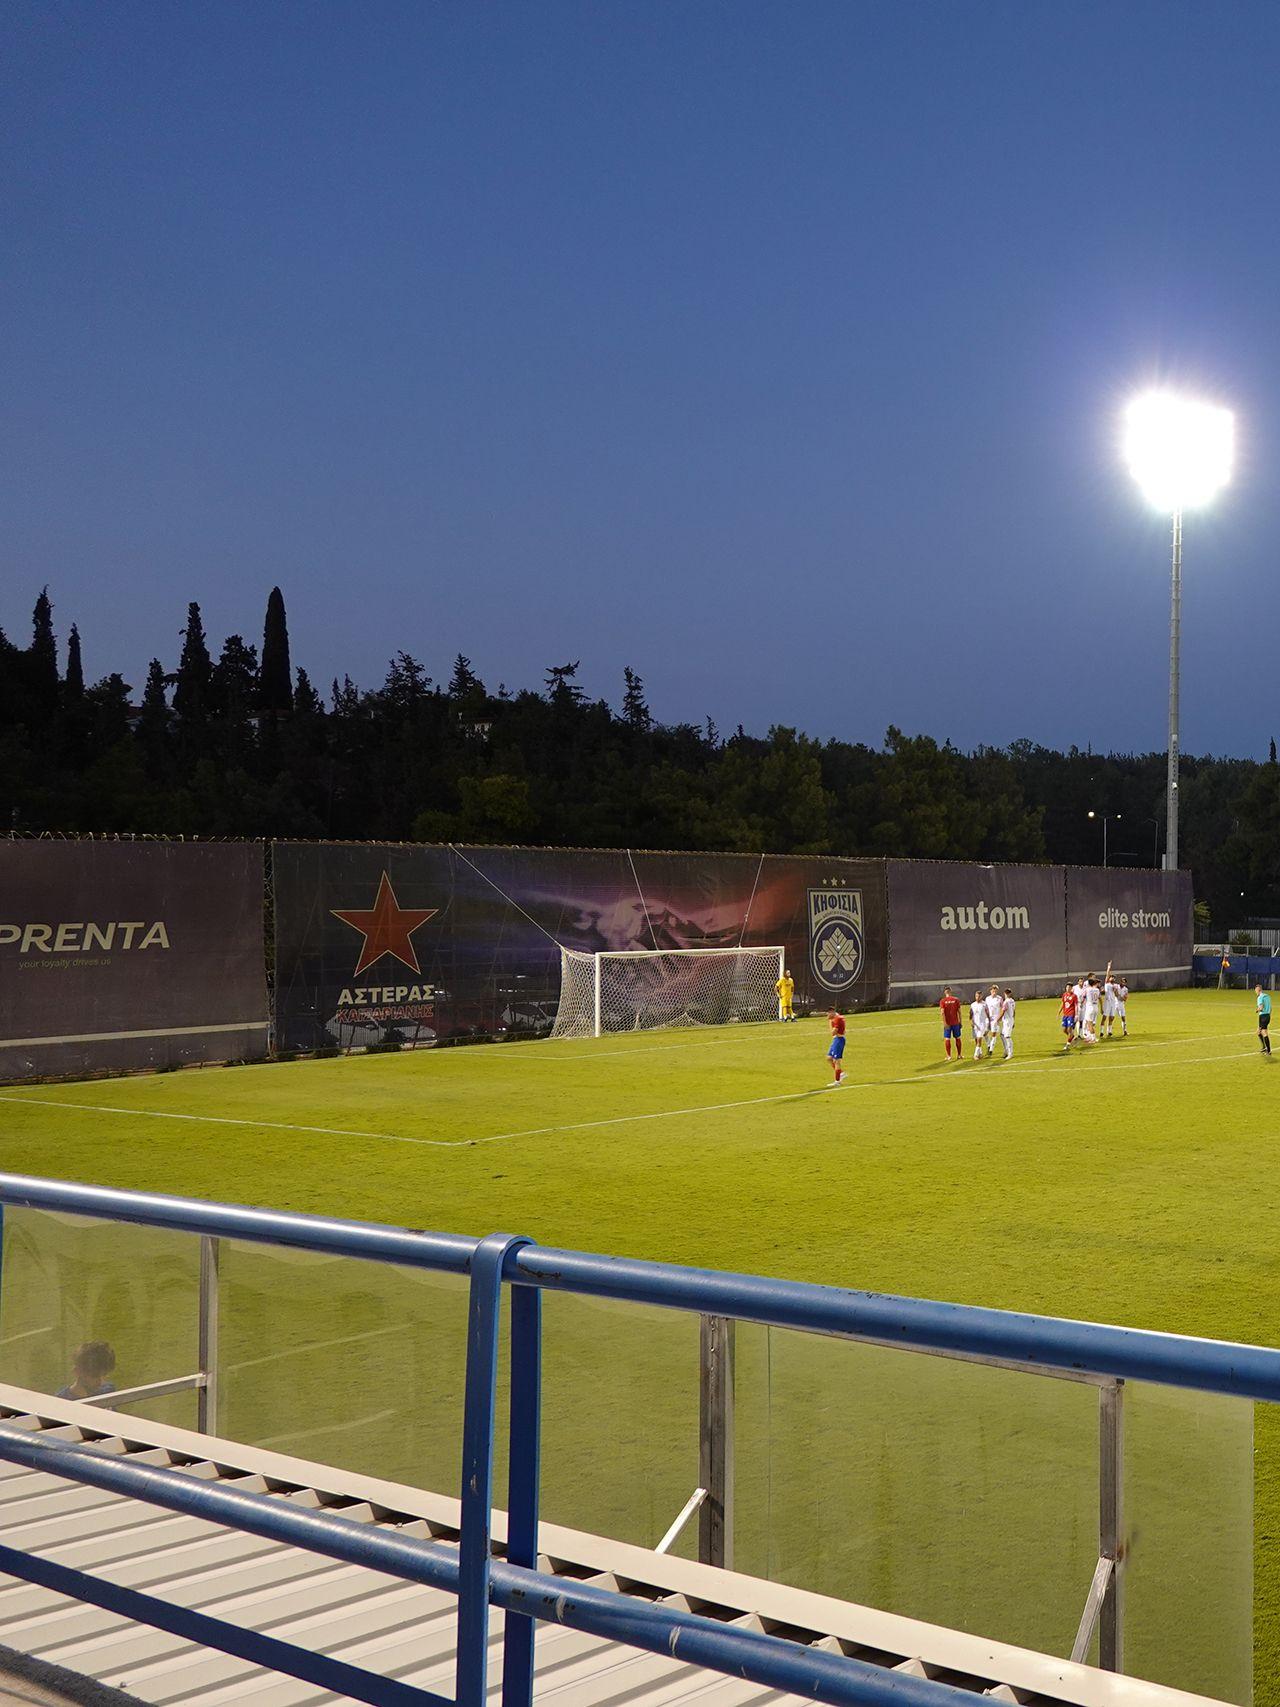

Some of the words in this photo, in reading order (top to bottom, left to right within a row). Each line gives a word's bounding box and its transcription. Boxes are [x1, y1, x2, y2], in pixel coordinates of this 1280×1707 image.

[813, 894, 859, 915] ΚΗΦΙΣΙΑ
[940, 901, 1030, 930] autom
[1098, 908, 1129, 928] elite
[1131, 909, 1170, 928] strom
[0, 921, 170, 953] PRENTA
[18, 961, 39, 970] your
[41, 958, 70, 969] loyalty
[337, 984, 435, 1006] ΑΣΤΕΡΑΣ
